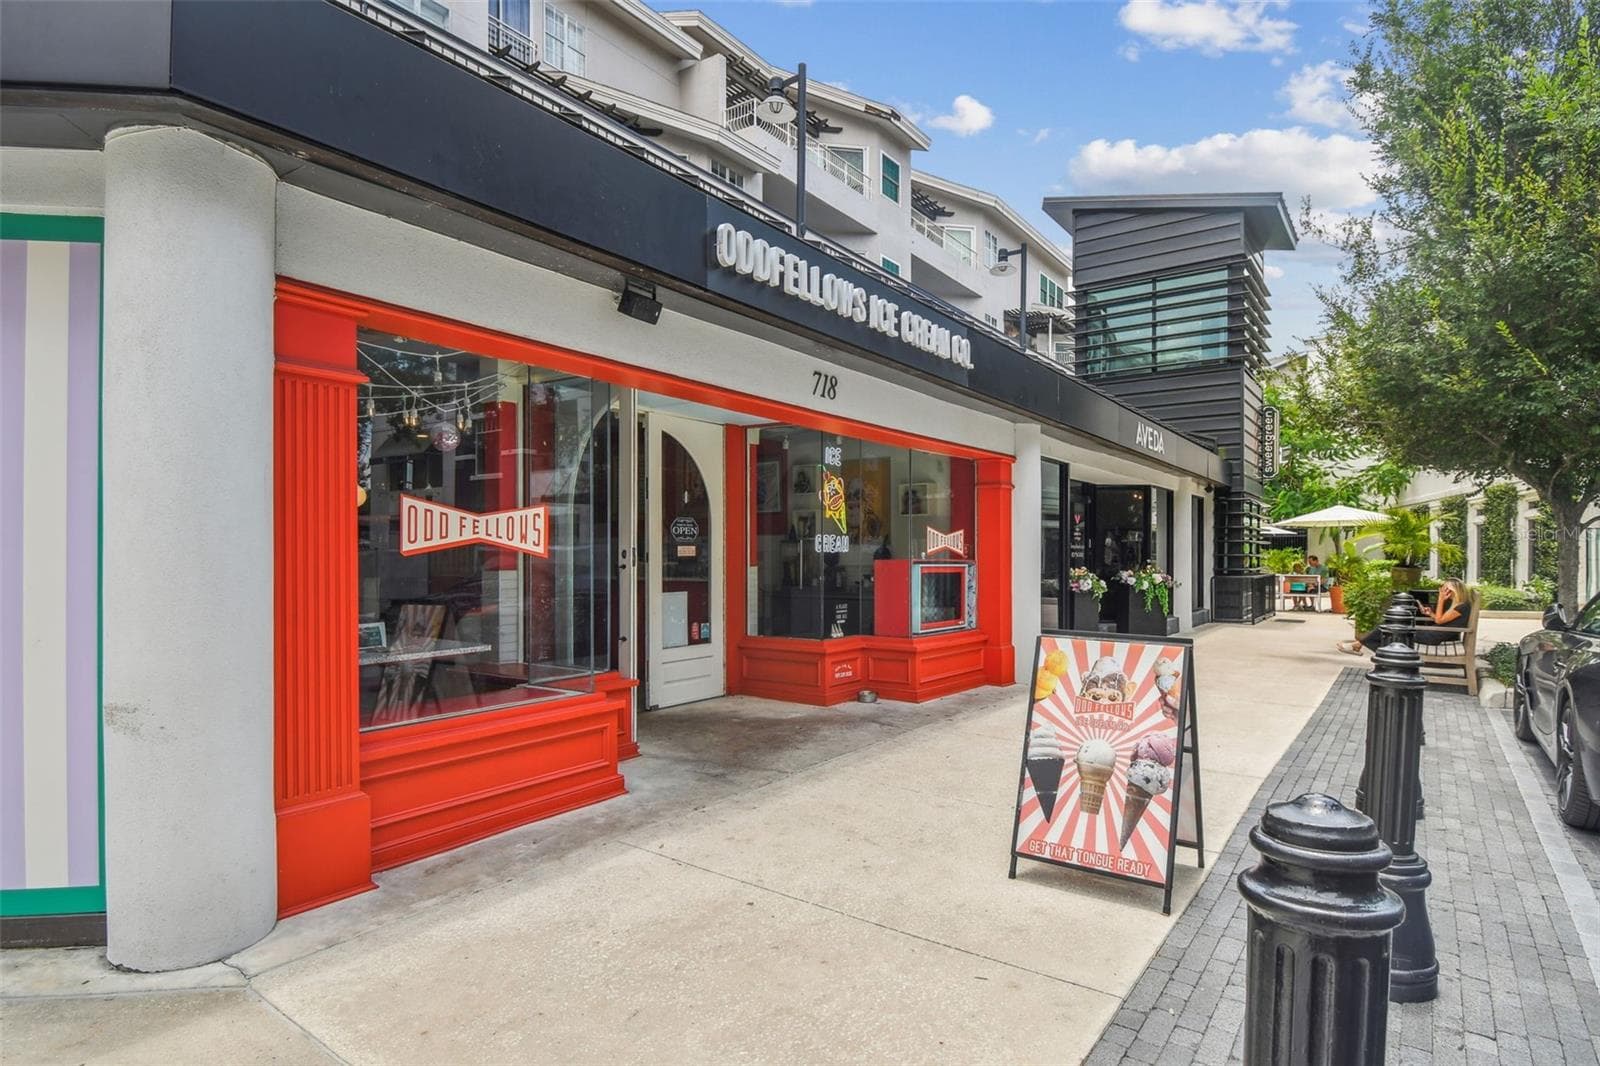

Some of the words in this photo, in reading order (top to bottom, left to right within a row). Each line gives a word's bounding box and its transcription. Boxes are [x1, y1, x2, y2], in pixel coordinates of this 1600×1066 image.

[716, 223, 866, 323] ODDFELLOWS
[869, 294, 899, 337] ICE
[901, 311, 951, 359] CREAM
[812, 370, 838, 400] 718
[1136, 421, 1165, 455] AVEDA
[1264, 410, 1276, 473] sweetgreen
[825, 446, 842, 467] ICE
[407, 505, 448, 544] ODD
[459, 512, 541, 546] FELLOWS
[672, 526, 697, 535] OPEN
[814, 534, 849, 553] CREAM
[1029, 839, 1047, 854] GET
[1049, 843, 1075, 860] THAT
[1077, 849, 1114, 868] TONGUE
[1117, 859, 1151, 876] READY
